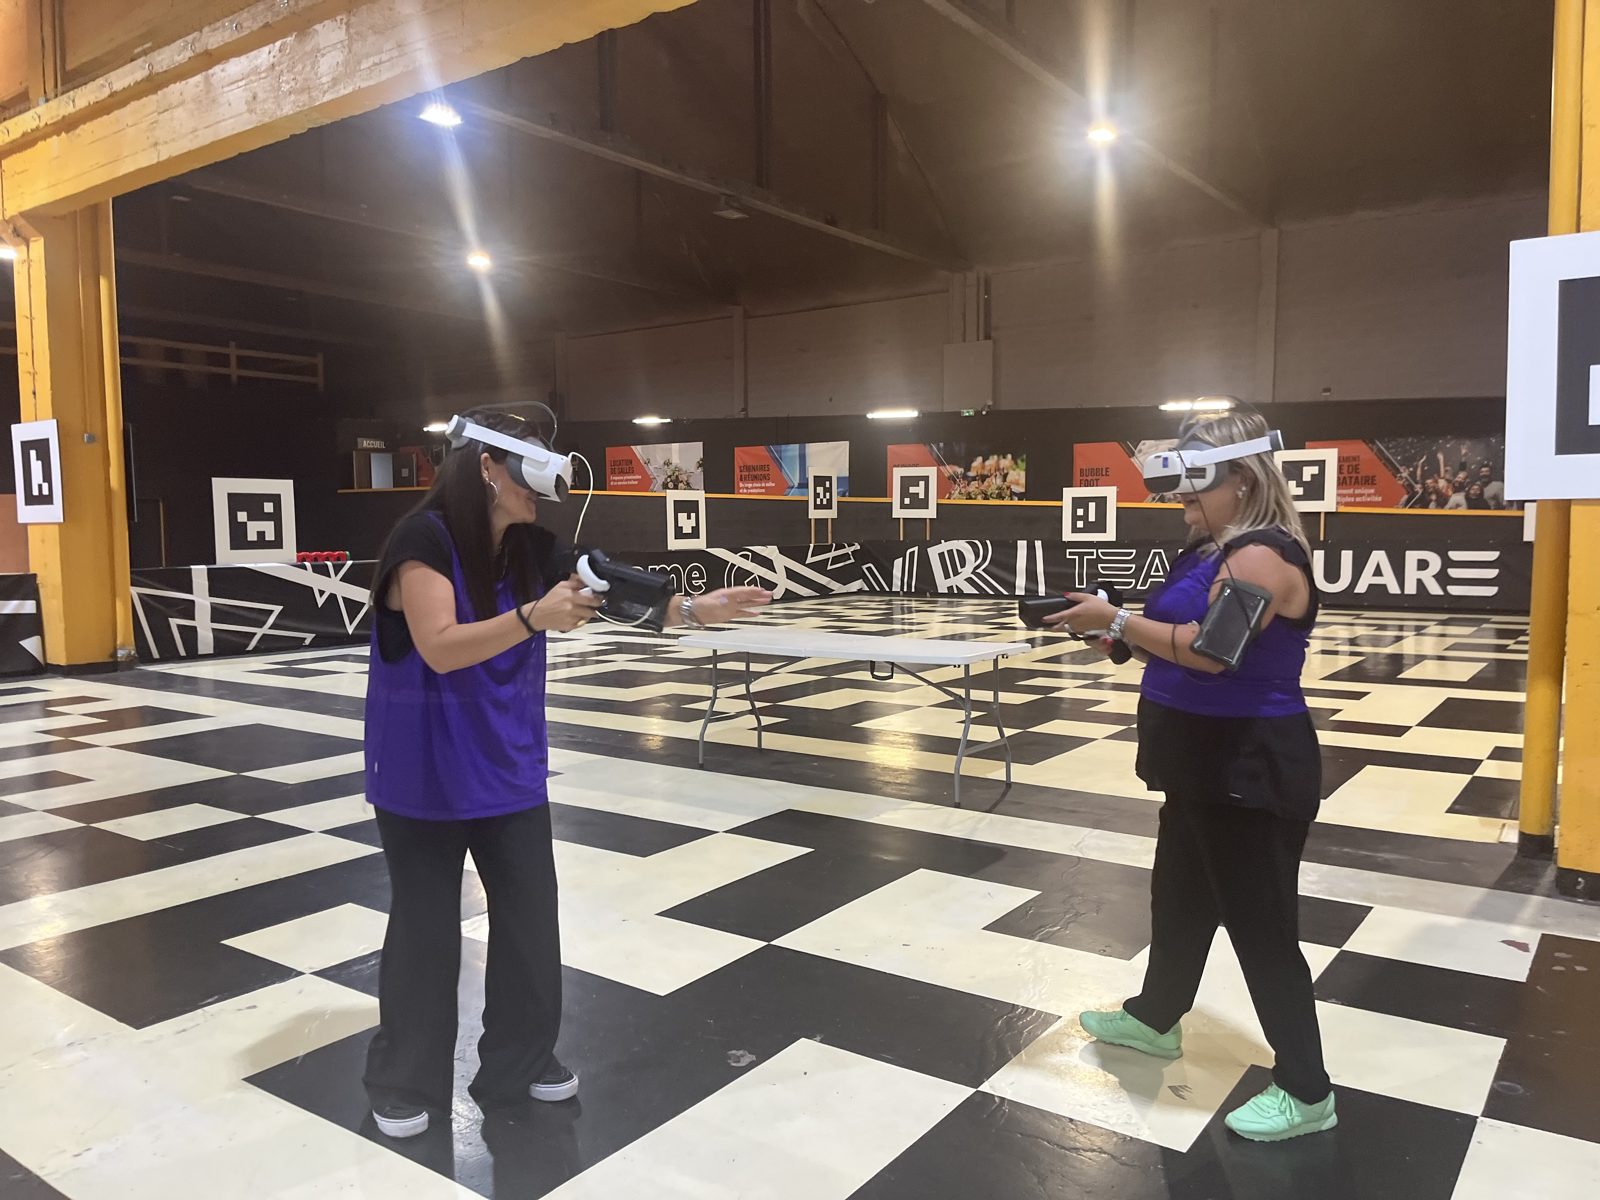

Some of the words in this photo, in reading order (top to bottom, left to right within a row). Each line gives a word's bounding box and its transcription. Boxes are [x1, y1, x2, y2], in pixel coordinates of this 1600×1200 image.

[362, 440, 386, 449] ACCUEIL
[610, 458, 634, 468] LOCATION
[610, 466, 617, 475] DE
[617, 466, 635, 475] SALLES
[1079, 467, 1110, 478] BUBBLE
[1347, 463, 1360, 475] DE
[1079, 478, 1100, 488] FOOT
[1337, 475, 1377, 487] BATAIRE
[1066, 549, 1184, 590] TEA
[1312, 549, 1500, 597] UARE
